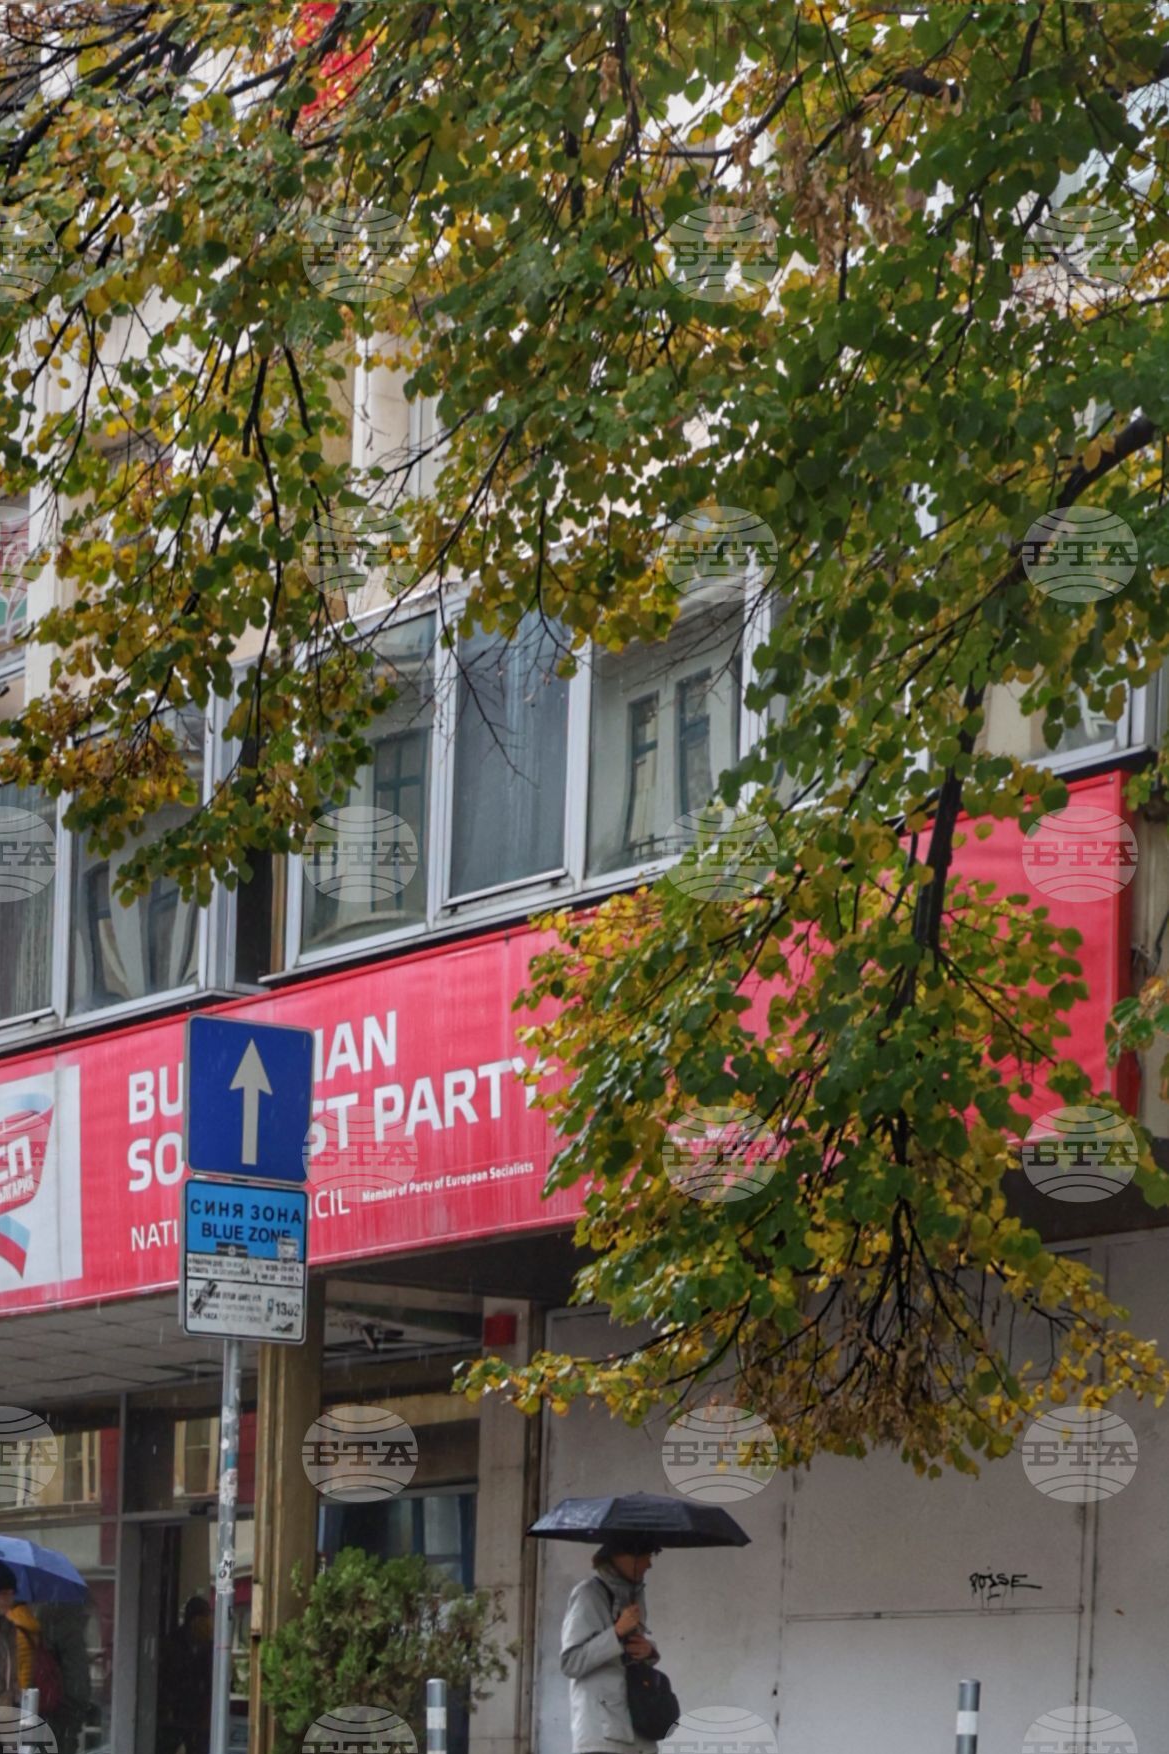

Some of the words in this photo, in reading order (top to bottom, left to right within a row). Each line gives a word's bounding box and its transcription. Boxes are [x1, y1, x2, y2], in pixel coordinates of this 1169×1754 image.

[374, 1056, 548, 1142] PARTY
[362, 1187, 396, 1203] Member
[398, 1184, 408, 1196] of
[409, 1179, 433, 1194] Party
[434, 1176, 445, 1188] of
[445, 1170, 488, 1188] European
[489, 1161, 535, 1180] Socialists
[190, 1199, 244, 1219] СИНЯ
[250, 1205, 302, 1224] ЗОНА
[201, 1222, 244, 1241] BLUE
[248, 1227, 292, 1243] ZONE
